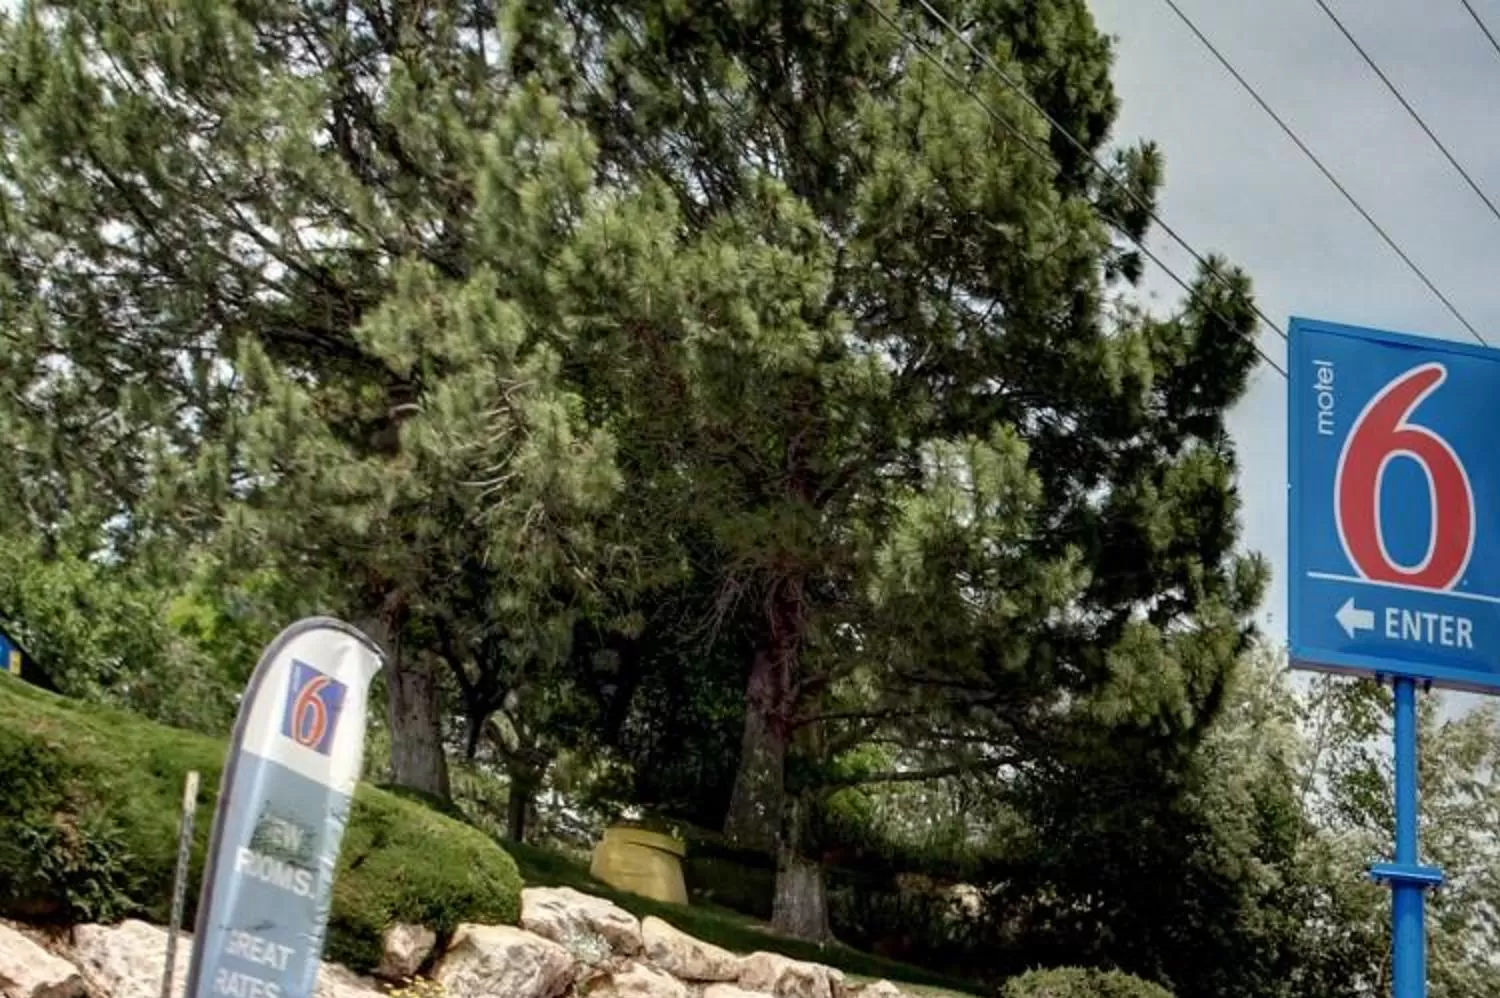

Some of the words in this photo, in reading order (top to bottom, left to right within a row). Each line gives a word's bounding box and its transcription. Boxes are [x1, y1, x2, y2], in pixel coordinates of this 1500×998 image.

[1312, 360, 1335, 435] motel
[1334, 361, 1476, 591] 6
[1385, 607, 1473, 649] ENTER
[291, 675, 329, 749] 6
[225, 930, 296, 971] GREAT
